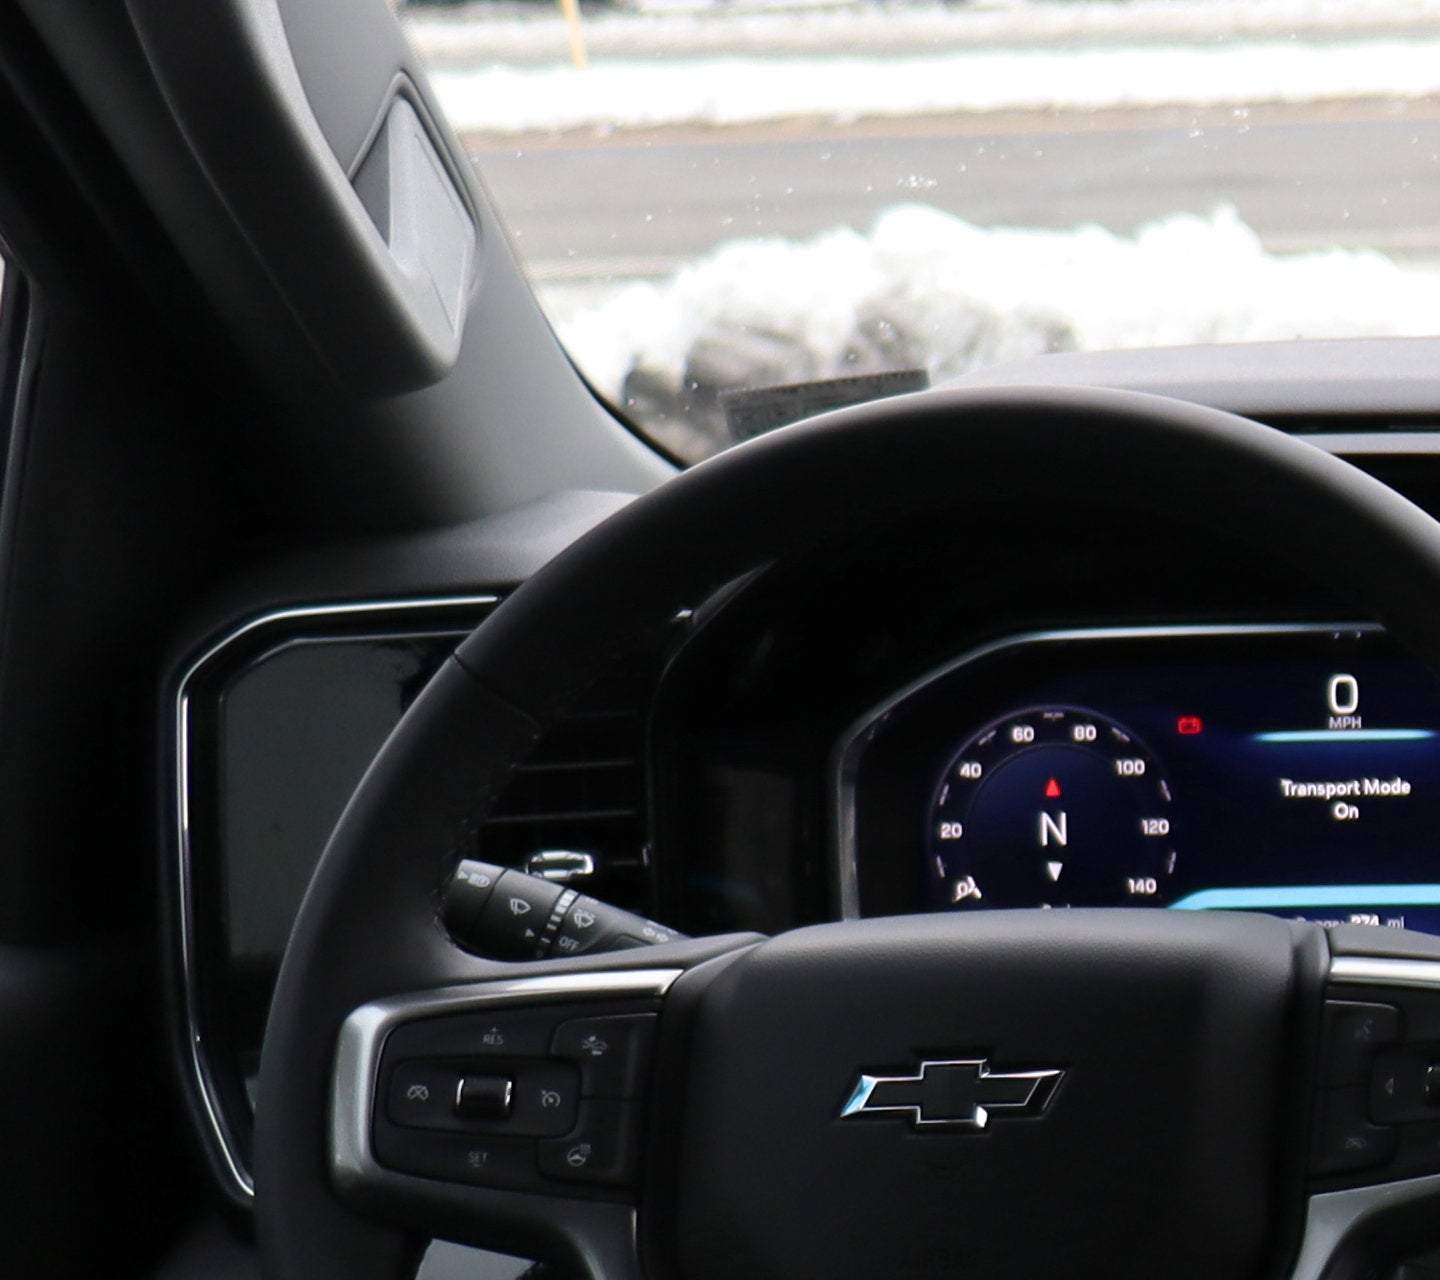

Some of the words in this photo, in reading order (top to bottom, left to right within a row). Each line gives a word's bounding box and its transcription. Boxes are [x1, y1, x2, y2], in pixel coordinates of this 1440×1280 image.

[1328, 673, 1359, 715] 0
[1329, 716, 1362, 729] MPH
[1012, 725, 1035, 742] 60
[1073, 724, 1097, 741] 80
[960, 762, 982, 779] 40
[1116, 759, 1145, 776] 100
[1280, 778, 1361, 799] Transport
[1364, 777, 1411, 796] Mode
[1333, 802, 1360, 820] On
[940, 822, 962, 839] 20
[1041, 811, 1067, 846] N
[1141, 818, 1170, 835] 120
[1127, 877, 1157, 894] 140
[559, 936, 579, 951] OFF
[482, 1033, 504, 1045] RES
